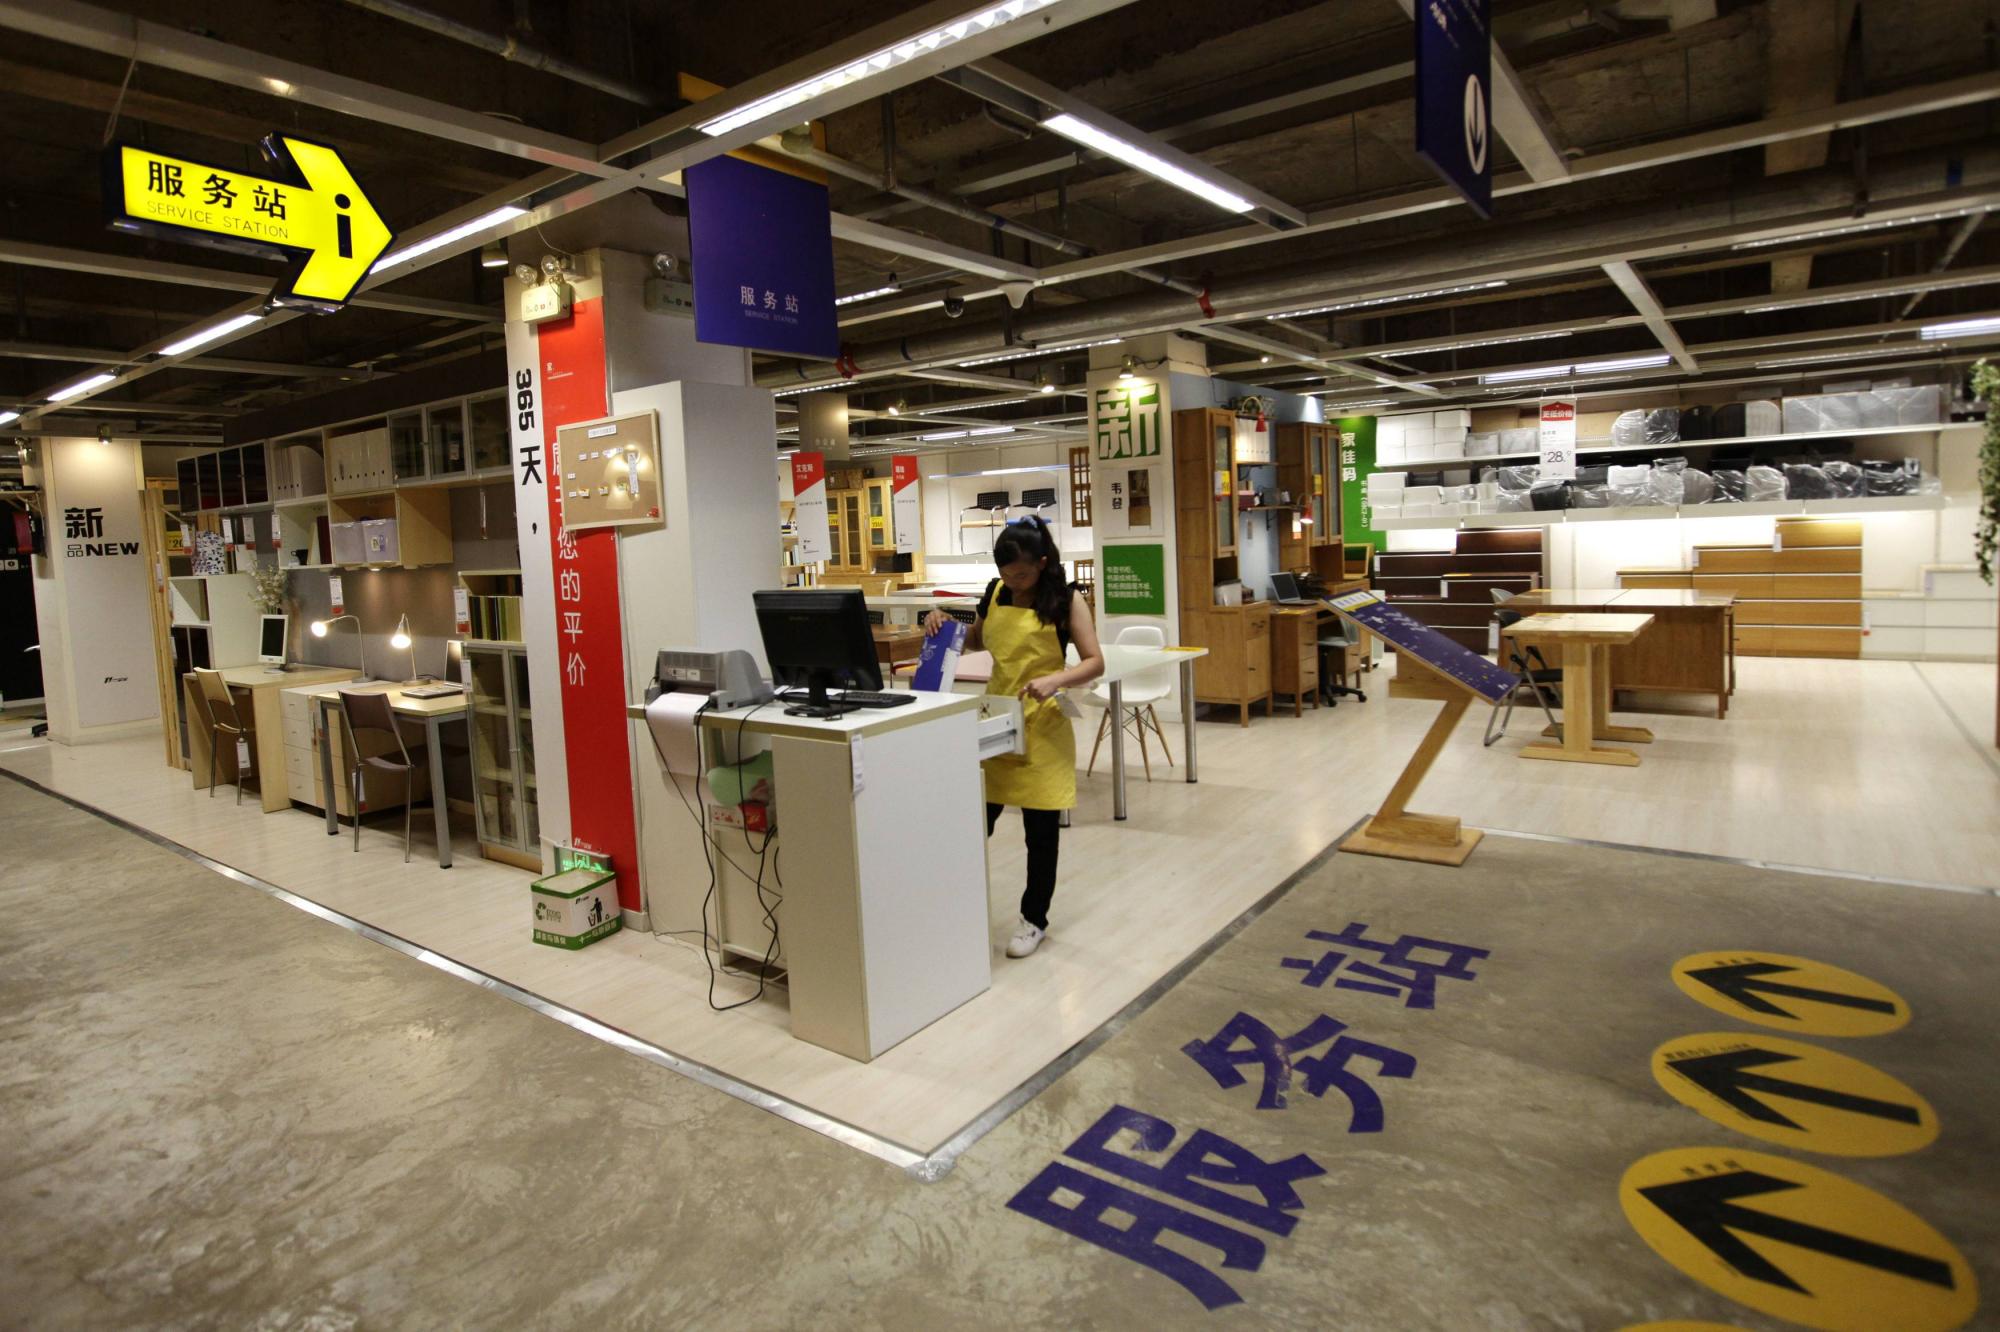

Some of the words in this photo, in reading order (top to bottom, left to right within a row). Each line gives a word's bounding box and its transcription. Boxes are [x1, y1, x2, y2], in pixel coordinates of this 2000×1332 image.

[148, 160, 287, 221] 服务站
[147, 200, 213, 225] SERVICE
[223, 216, 289, 239] STATION
[740, 285, 799, 314] 服务站
[1098, 384, 1159, 459] 新
[65, 507, 103, 539] 新
[1005, 922, 1491, 1312] 服务站
